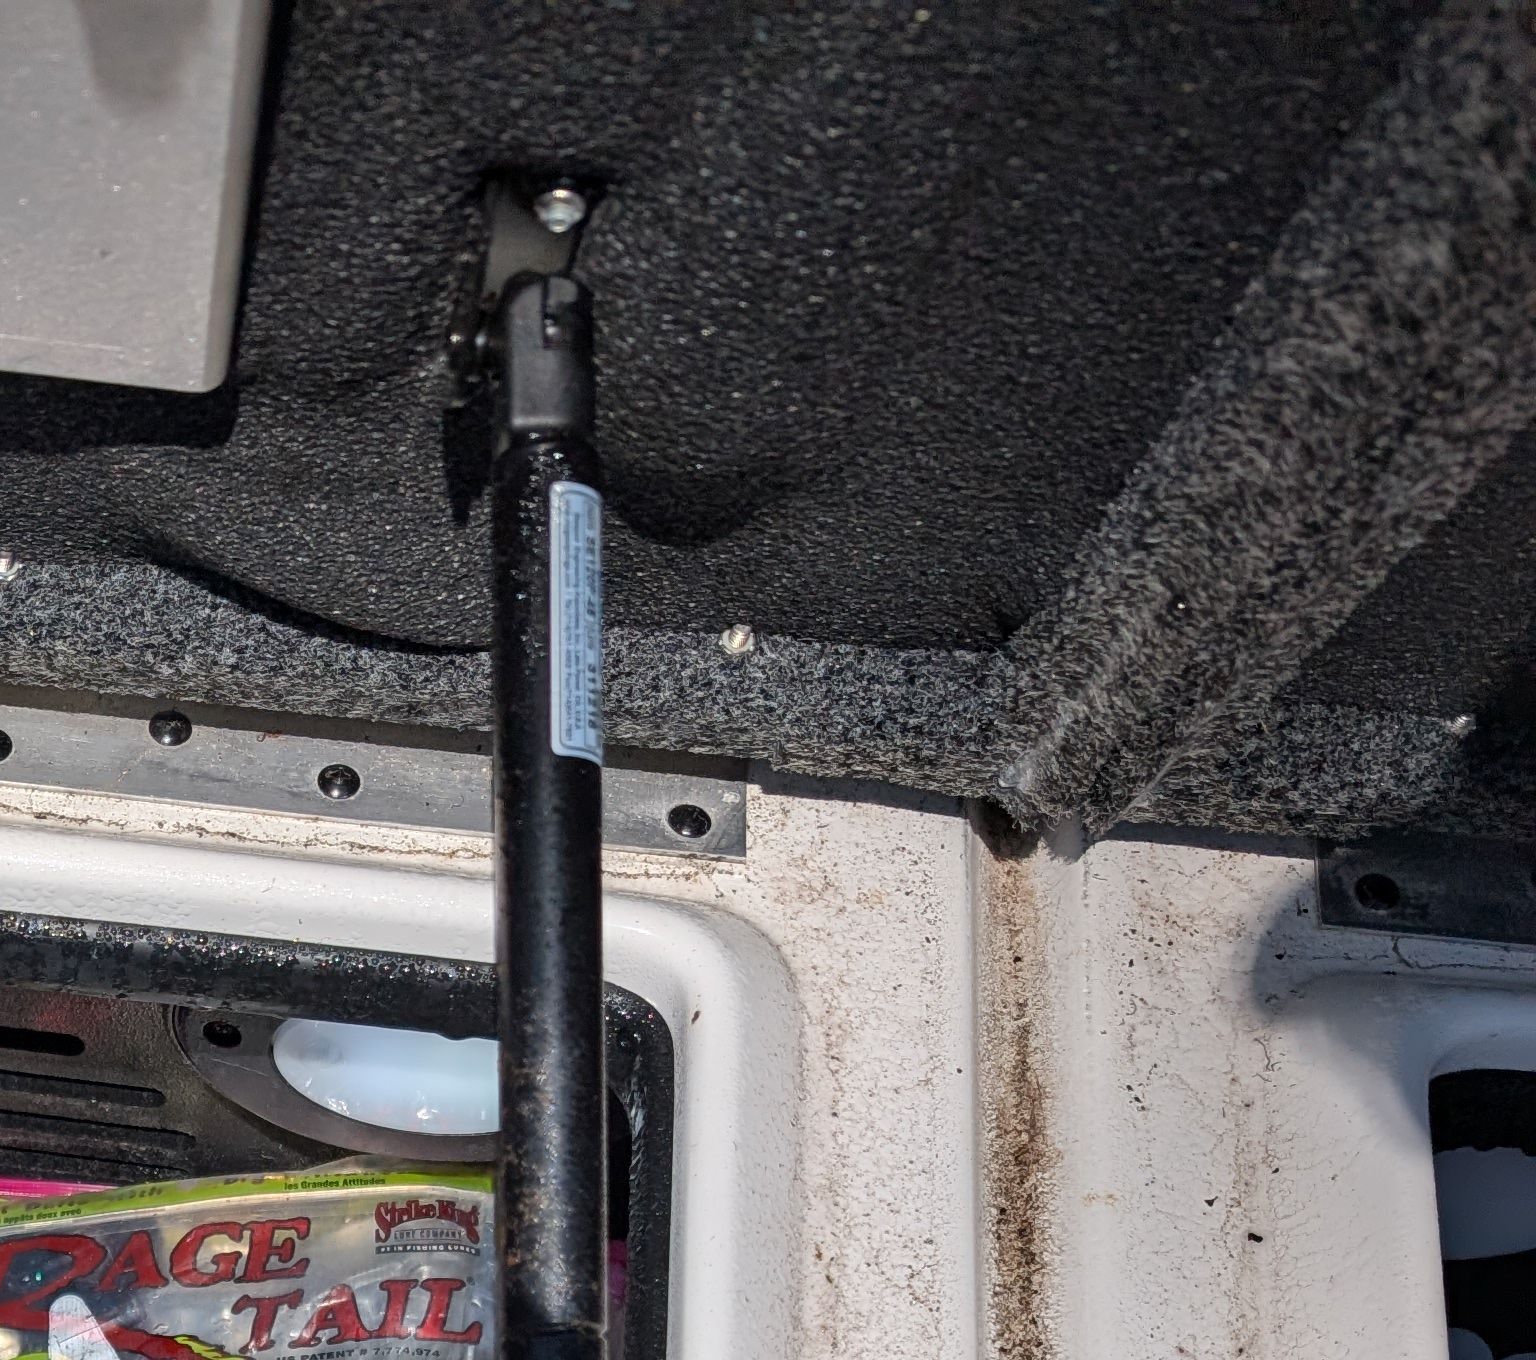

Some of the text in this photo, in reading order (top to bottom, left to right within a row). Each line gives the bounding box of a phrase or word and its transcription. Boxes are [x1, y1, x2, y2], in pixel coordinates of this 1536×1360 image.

[301, 1179, 340, 1190] Grandes
[343, 1177, 386, 1188] Attitudes
[419, 1228, 464, 1240] COMPANY
[231, 1278, 483, 1354] TAIL
[373, 1346, 441, 1358] 7,774,974
